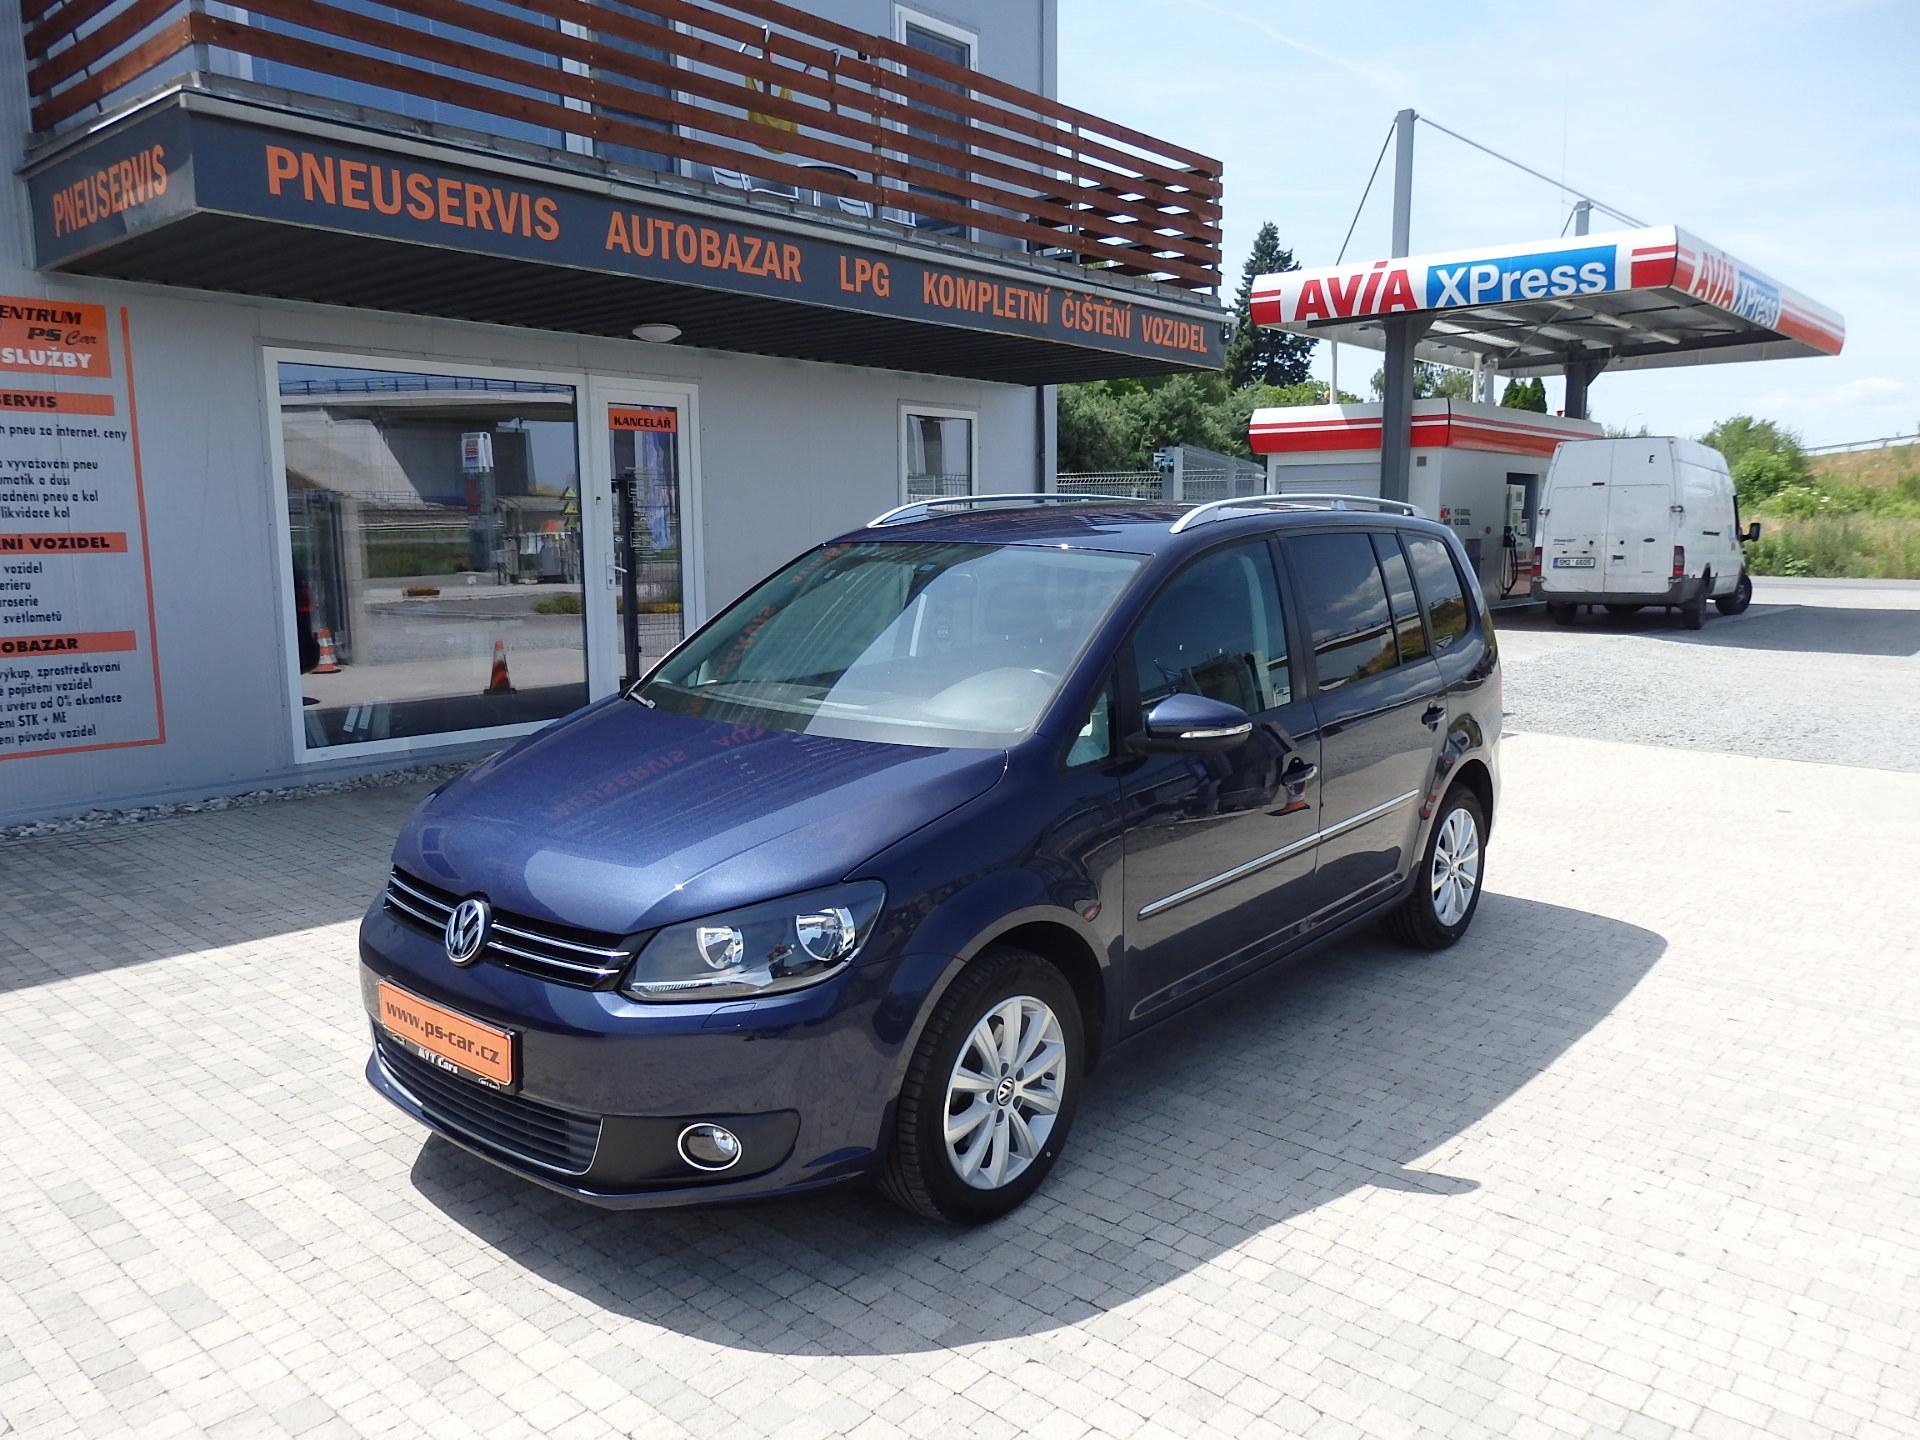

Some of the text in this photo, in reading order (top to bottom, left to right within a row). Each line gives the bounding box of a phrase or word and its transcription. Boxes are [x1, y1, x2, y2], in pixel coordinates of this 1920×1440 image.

[53, 144, 167, 237] PNEUSERVIS
[266, 145, 1217, 353] PNEUSERVIS AUTOBAZAR LPG KOMPLETNÍ ČIŠTĚNÍ VOZIDEL
[1434, 262, 1607, 310] XPress
[28, 327, 97, 346] PS Car
[1, 346, 92, 369] SLUŽBY
[0, 394, 57, 409] ERVIS
[614, 415, 671, 429] KANCELÁŘ
[9, 425, 36, 438] pneu
[103, 430, 128, 441] ceny
[73, 460, 99, 472] pneu
[39, 477, 46, 486] a
[0, 490, 99, 504] adnění pneu a kol
[1, 505, 71, 519] likvidace kol
[29, 537, 110, 550] VOZIDEL
[4, 562, 43, 574] vozidel
[1, 638, 78, 653] OBAZAR
[56, 678, 93, 692] vozidel
[40, 696, 53, 709] od
[57, 694, 73, 708] 0%
[76, 693, 122, 706] akontace
[18, 713, 39, 727] STK
[52, 711, 67, 724] ME
[59, 724, 97, 739] vozidel
[386, 1001, 500, 1065] www.ps-car.cz
